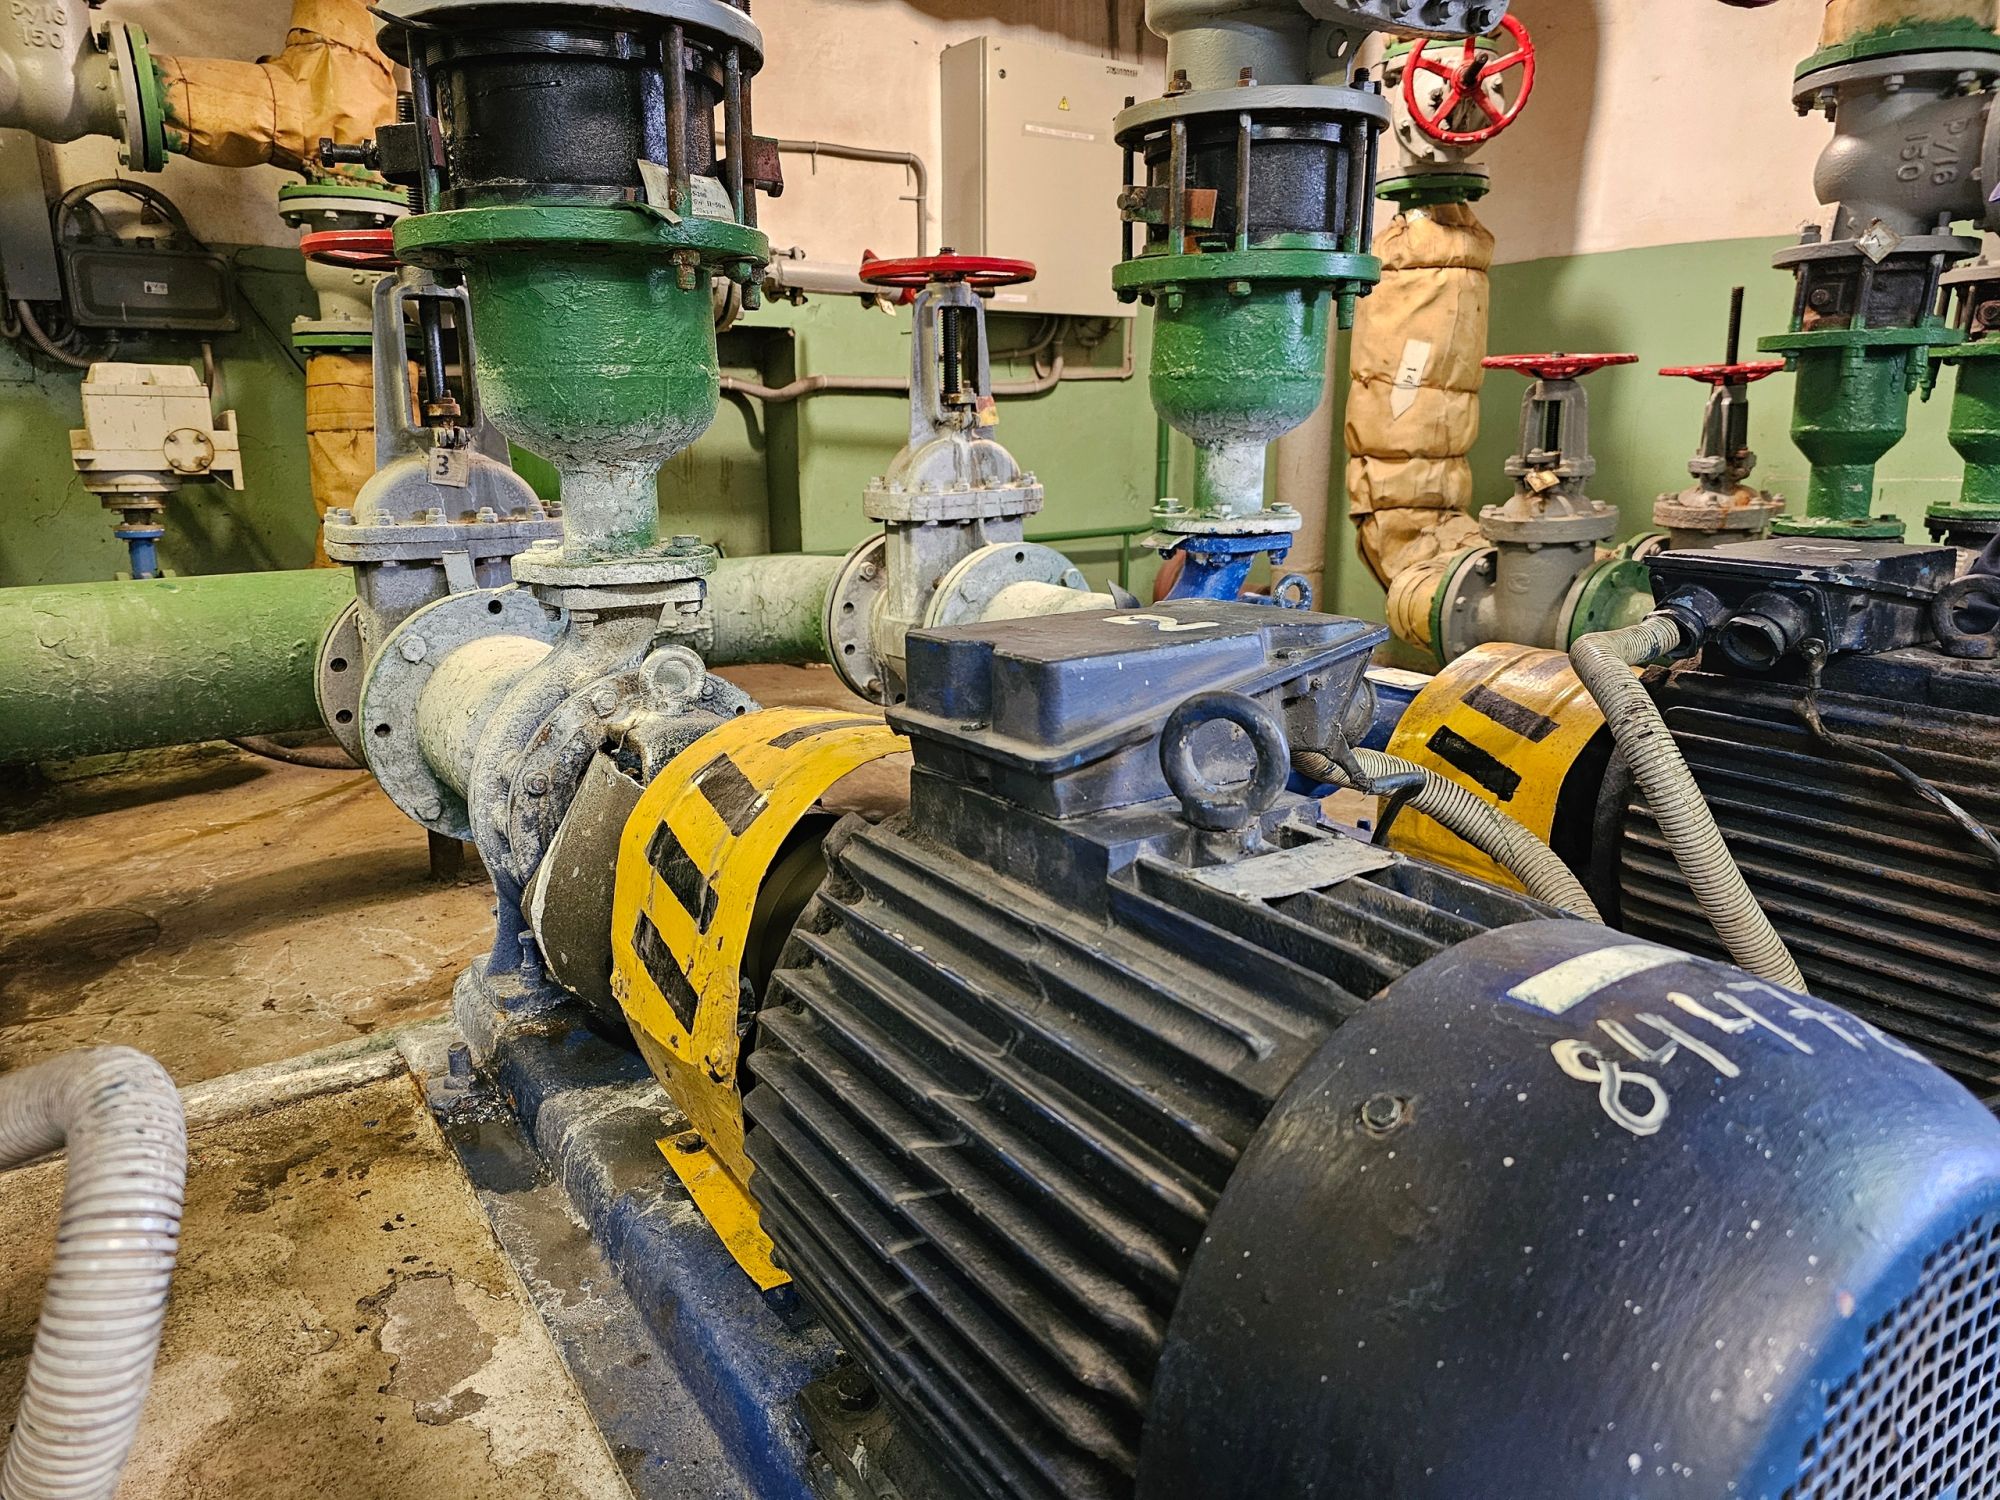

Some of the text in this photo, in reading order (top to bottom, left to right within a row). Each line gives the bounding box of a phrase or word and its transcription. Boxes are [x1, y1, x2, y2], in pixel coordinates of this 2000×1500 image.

[20, 27, 65, 50] 150
[1895, 130, 1930, 183] 150
[435, 454, 450, 476] 3
[1102, 614, 1220, 632] 2
